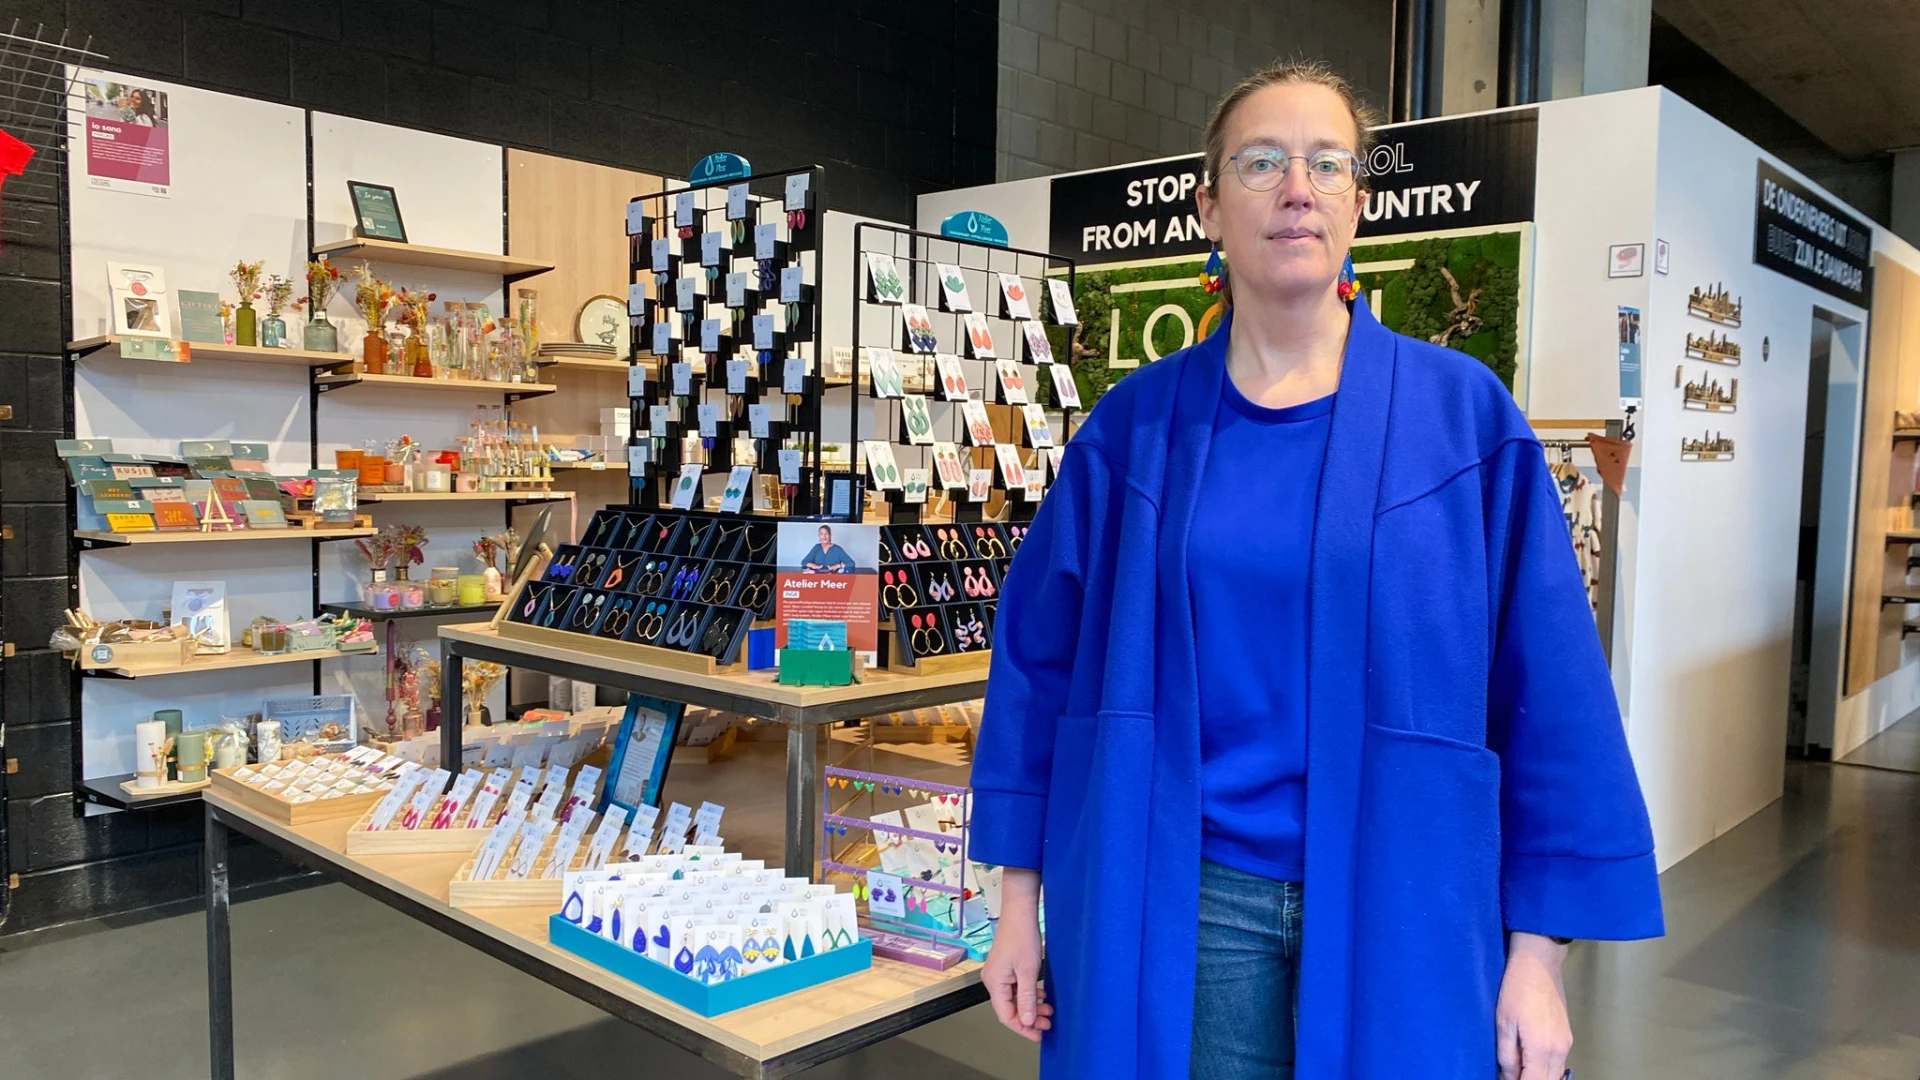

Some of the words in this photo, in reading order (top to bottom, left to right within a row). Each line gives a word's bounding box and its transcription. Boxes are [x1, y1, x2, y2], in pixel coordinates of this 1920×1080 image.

[1126, 172, 1197, 207] STOP
[1082, 218, 1156, 252] FROM
[1163, 213, 1206, 244] AN
[1362, 180, 1482, 222] UNTRY
[115, 467, 149, 475] KUSJE
[783, 579, 818, 589] Atelier
[820, 579, 848, 589] Meer
